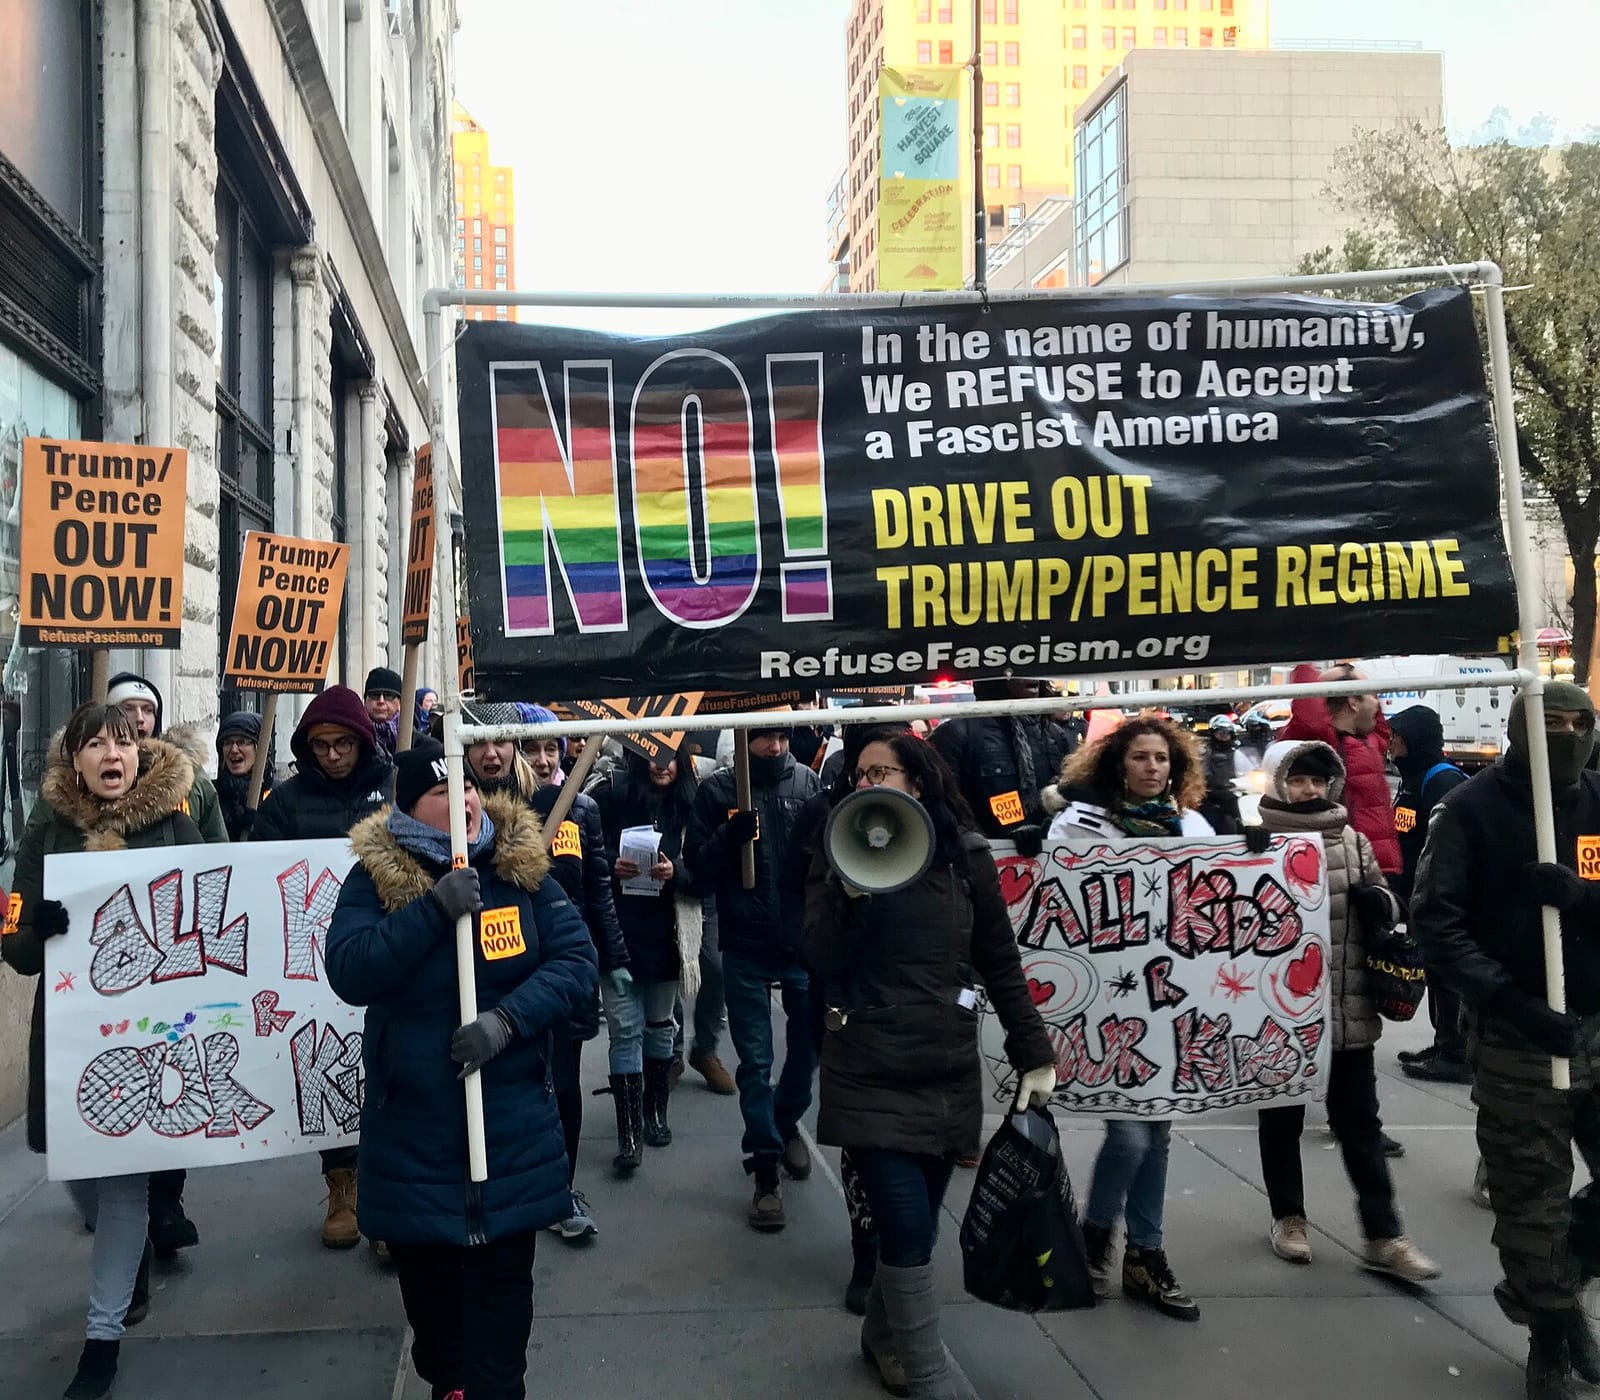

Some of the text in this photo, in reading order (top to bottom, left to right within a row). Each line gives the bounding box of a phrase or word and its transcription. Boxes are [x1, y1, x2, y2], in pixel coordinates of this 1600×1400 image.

[897, 106, 941, 152] HARVEST
[914, 123, 954, 165] SQUARE
[891, 184, 954, 232] CELEBRATION
[861, 310, 1425, 364] In the name of humanity,
[861, 357, 1354, 414] We REFUSE to Accept
[864, 407, 1279, 460] a Fascist America
[40, 444, 173, 487] Trump/
[50, 480, 162, 516] Pence
[489, 347, 834, 638] NO!
[871, 474, 1153, 550] DRIVE OUT
[53, 519, 157, 569] OUT
[257, 537, 341, 573] Trump/
[30, 572, 172, 622] NOW!
[257, 565, 329, 595] Pence
[876, 538, 1471, 630] TRUMP/PENCE REGIME
[39, 628, 163, 645] RefuseFascism.org
[255, 594, 325, 634] OUT
[232, 633, 328, 674] NOW!
[760, 634, 1211, 680] RefuseFascism.org
[236, 677, 315, 692] RefuseFascism.org
[699, 689, 800, 712] efuseFascism.org
[996, 799, 1017, 813] OUT
[89, 865, 248, 994] ALL
[485, 920, 516, 938] OUT
[1017, 868, 1150, 953] ALL
[484, 934, 521, 953] NOW
[1143, 956, 1189, 1012] R
[252, 990, 296, 1037] R
[77, 1033, 275, 1138] OUR
